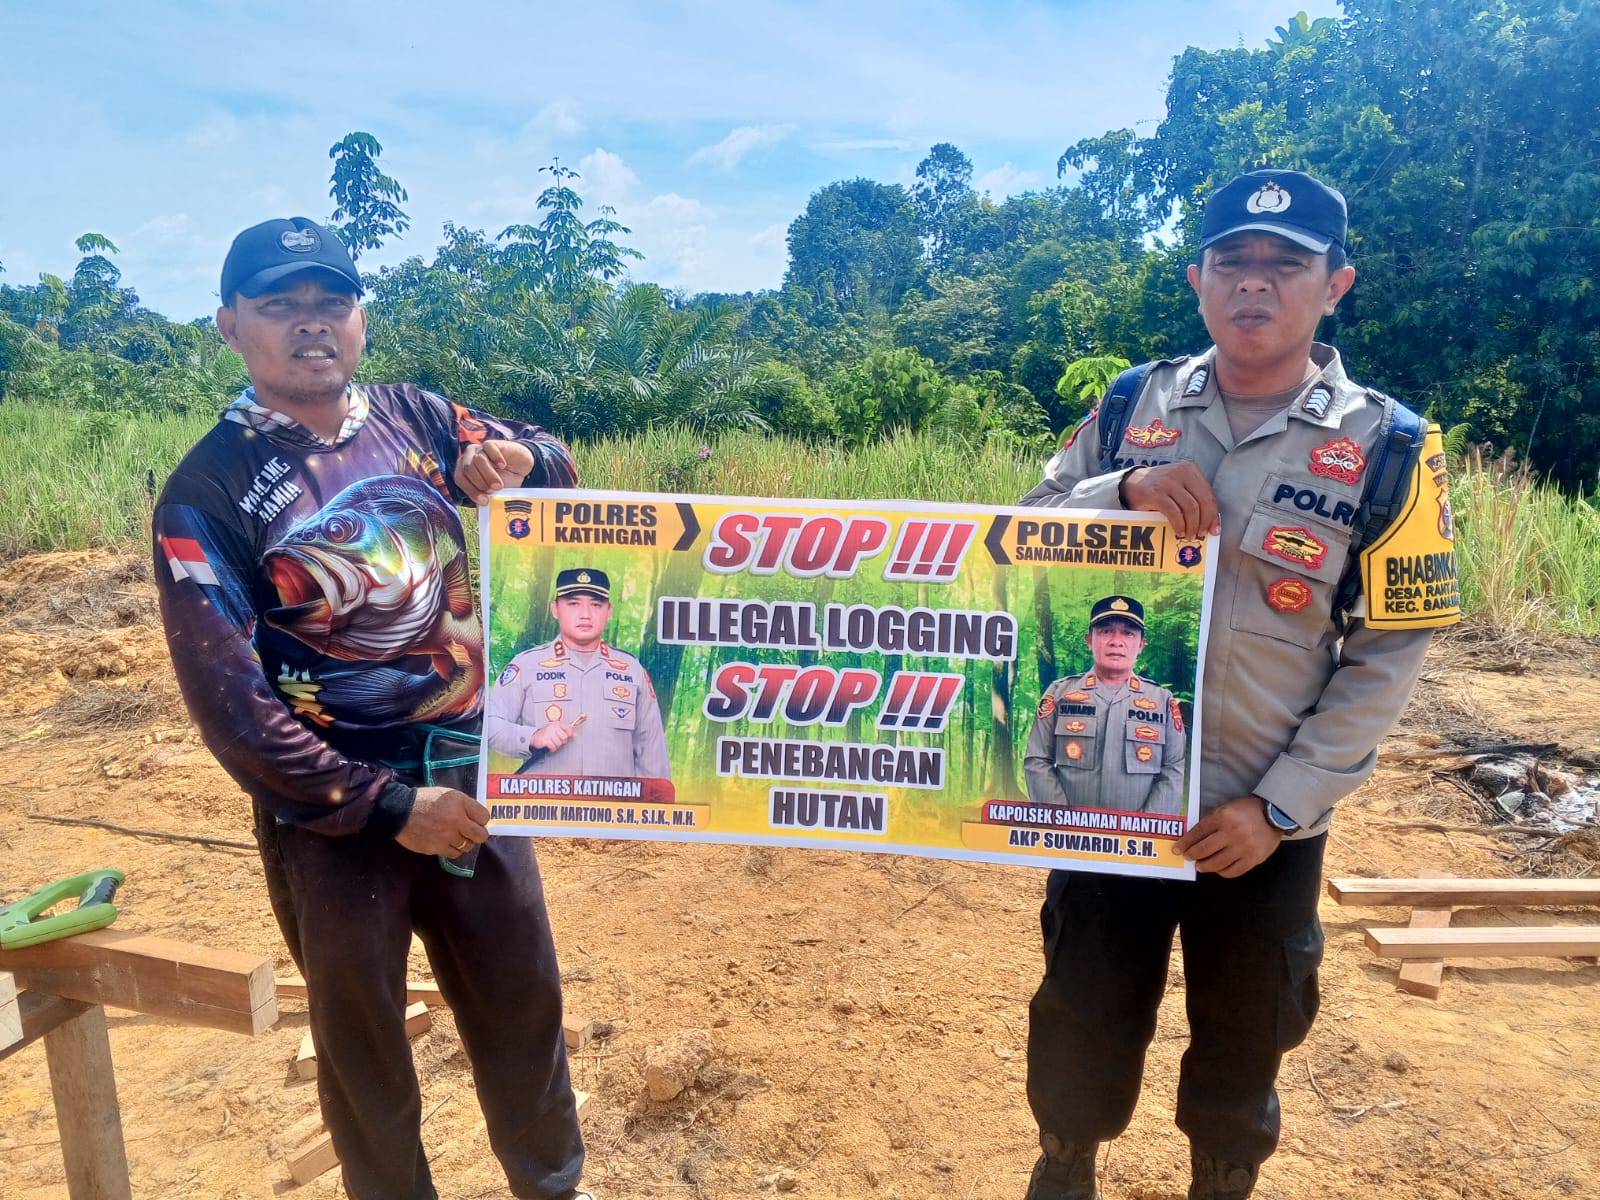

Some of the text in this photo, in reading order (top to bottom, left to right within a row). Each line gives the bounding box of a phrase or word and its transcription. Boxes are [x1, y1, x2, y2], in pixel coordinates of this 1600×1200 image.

[555, 502, 657, 526] POLRES
[1273, 483, 1359, 528] POLRI
[555, 527, 657, 546] KATINGAN
[709, 513, 974, 576] STOP !!!
[1017, 521, 1156, 552] POLSEK
[1015, 546, 1156, 567] SANAMAN MANTIKEI
[1384, 586, 1422, 600] DESA
[1385, 600, 1419, 613] KEC.
[662, 600, 1013, 658] ILLEGAL LOGGING
[536, 671, 566, 681] DODIK
[605, 671, 633, 683] POLRI
[707, 665, 960, 729] STOP !!!
[1127, 709, 1164, 723] POLRI
[720, 740, 940, 786] PENEBANGAN
[500, 778, 642, 798] KAPOLRES KATINGAN
[490, 805, 521, 820] AKBP
[523, 805, 558, 821] DODIK
[560, 806, 614, 824] HARTONO,
[616, 807, 639, 825] S.H.,
[673, 811, 696, 827] M.H.
[772, 791, 884, 831] HUTAN
[989, 804, 1184, 837] KAPOLSEK SANAMAN MANTIKEI
[1009, 829, 1158, 857] AKP SUWARDI, S.H.
